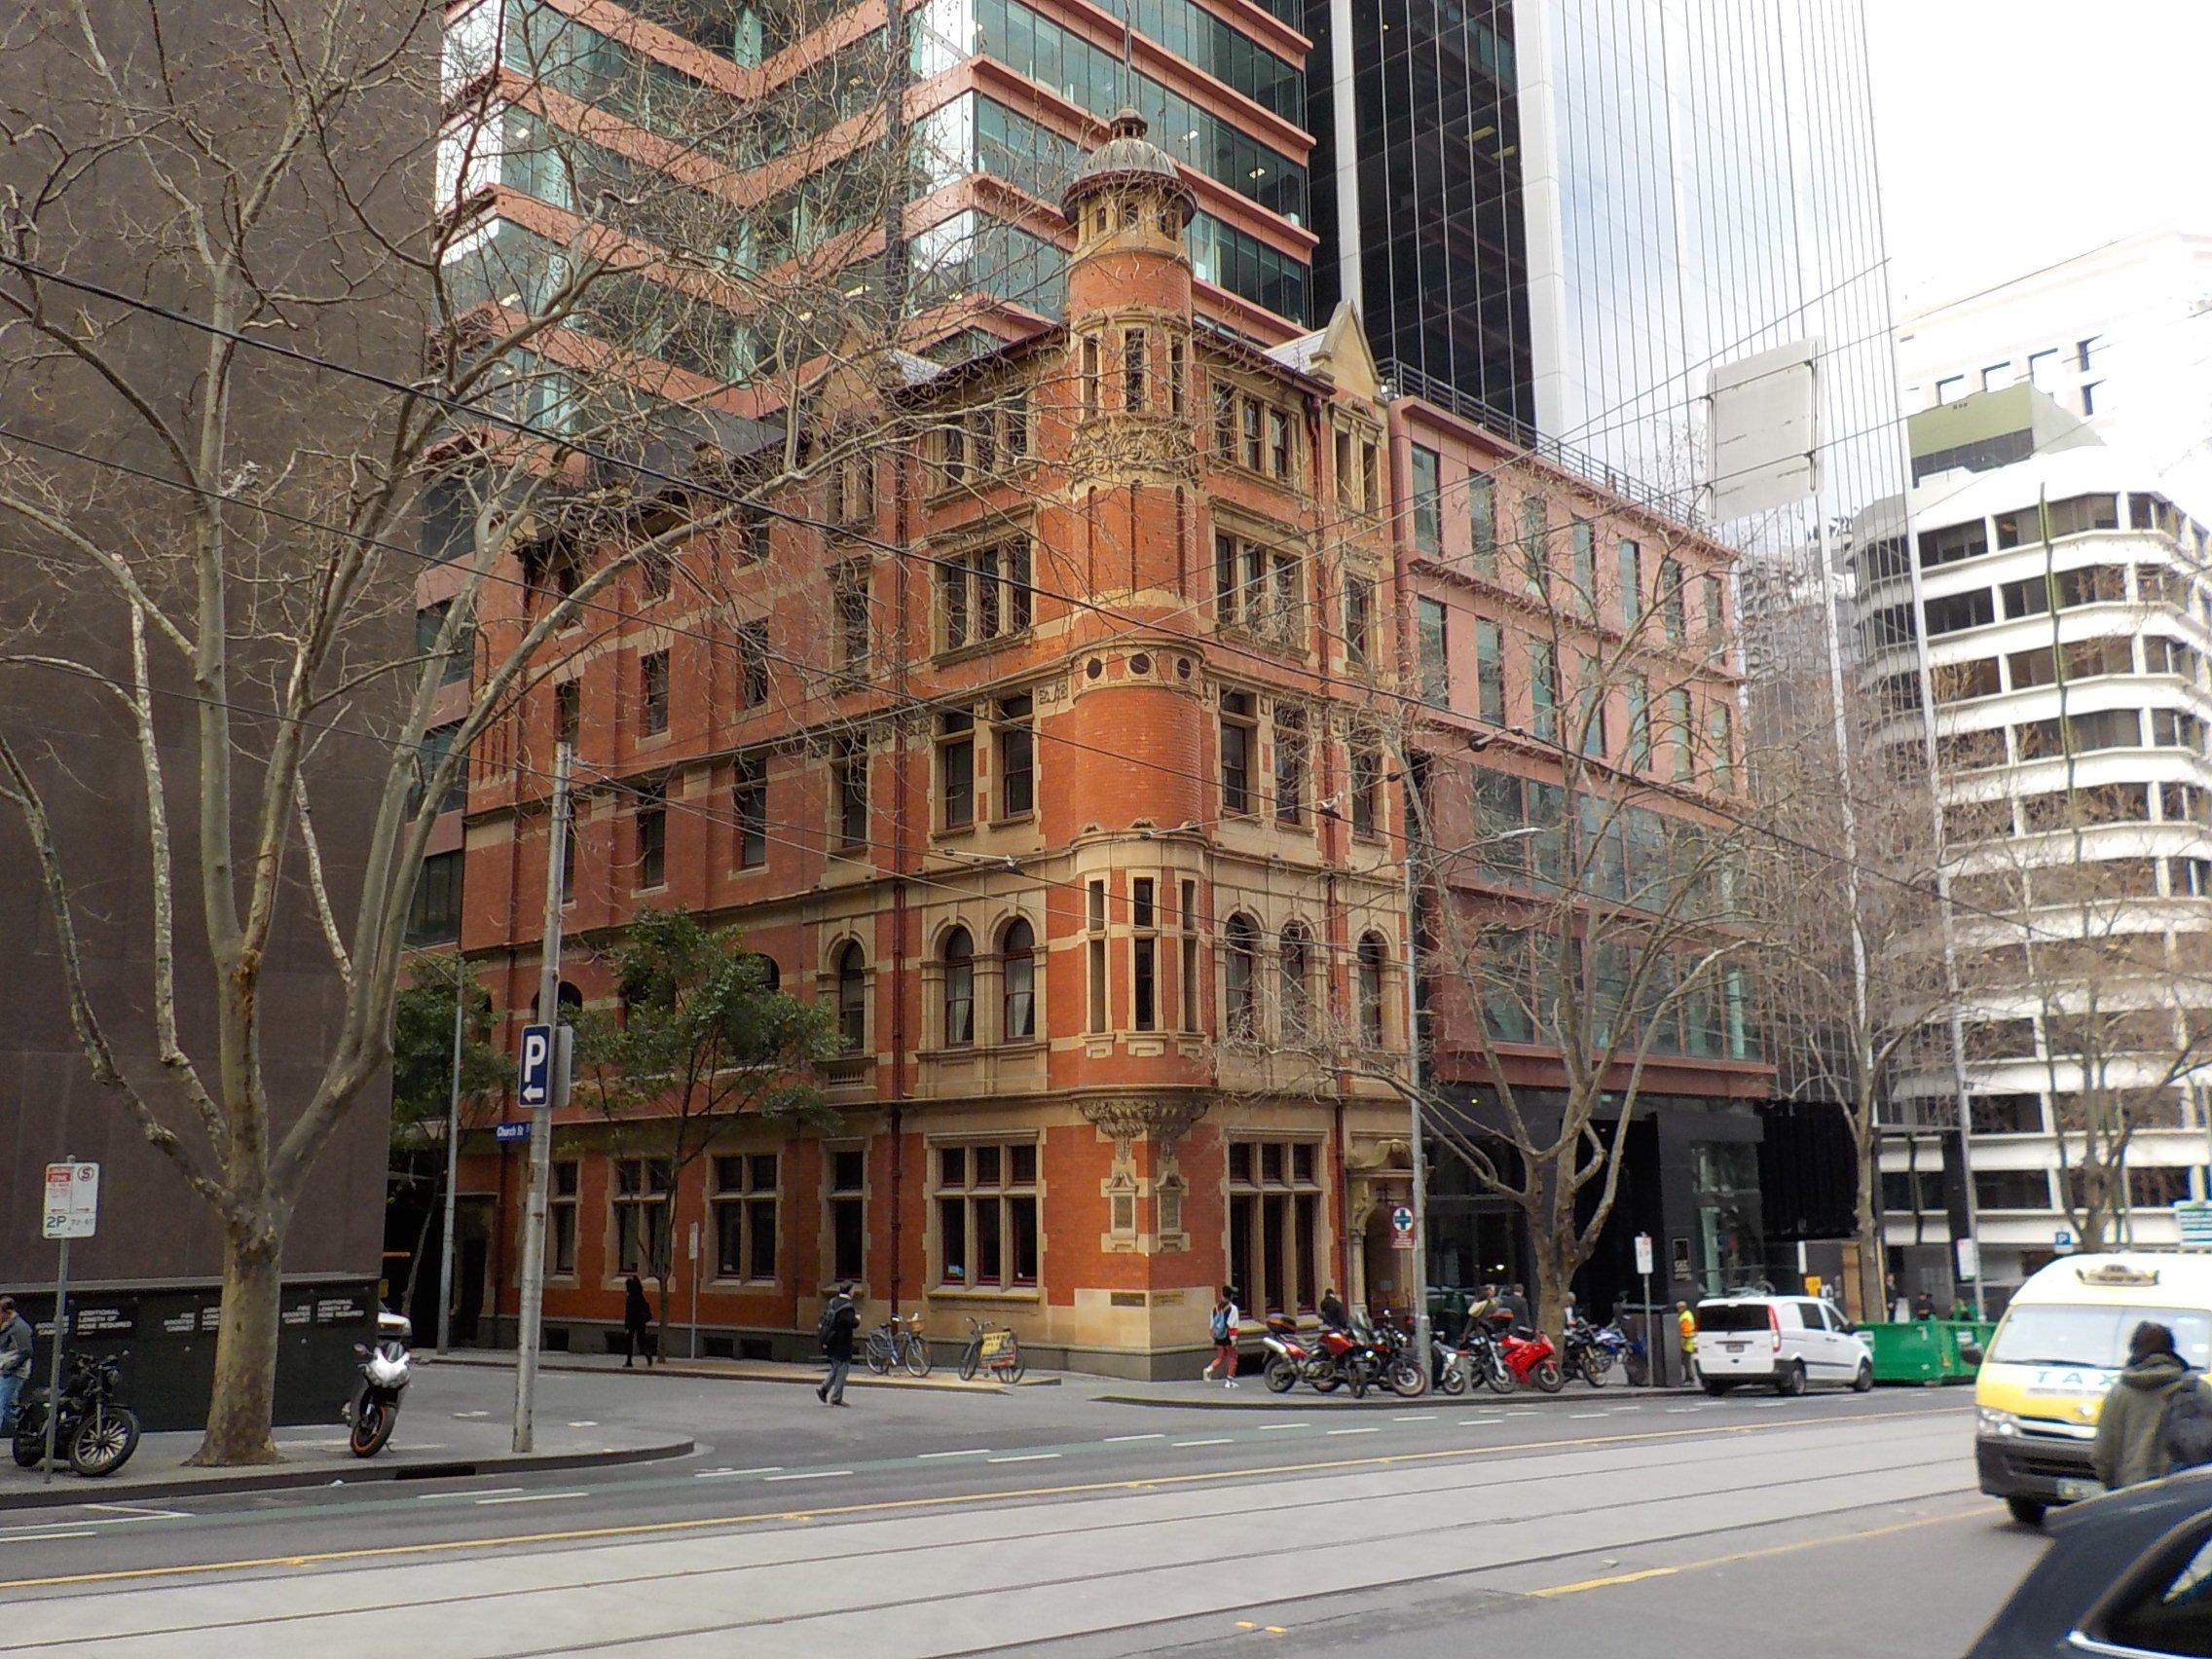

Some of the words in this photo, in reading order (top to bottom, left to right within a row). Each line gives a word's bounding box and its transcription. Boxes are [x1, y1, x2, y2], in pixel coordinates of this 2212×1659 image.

[524, 1034, 546, 1083] P
[497, 1124, 517, 1137] Church
[46, 1215, 67, 1229] 2P
[2037, 1370, 2120, 1386] TAX
